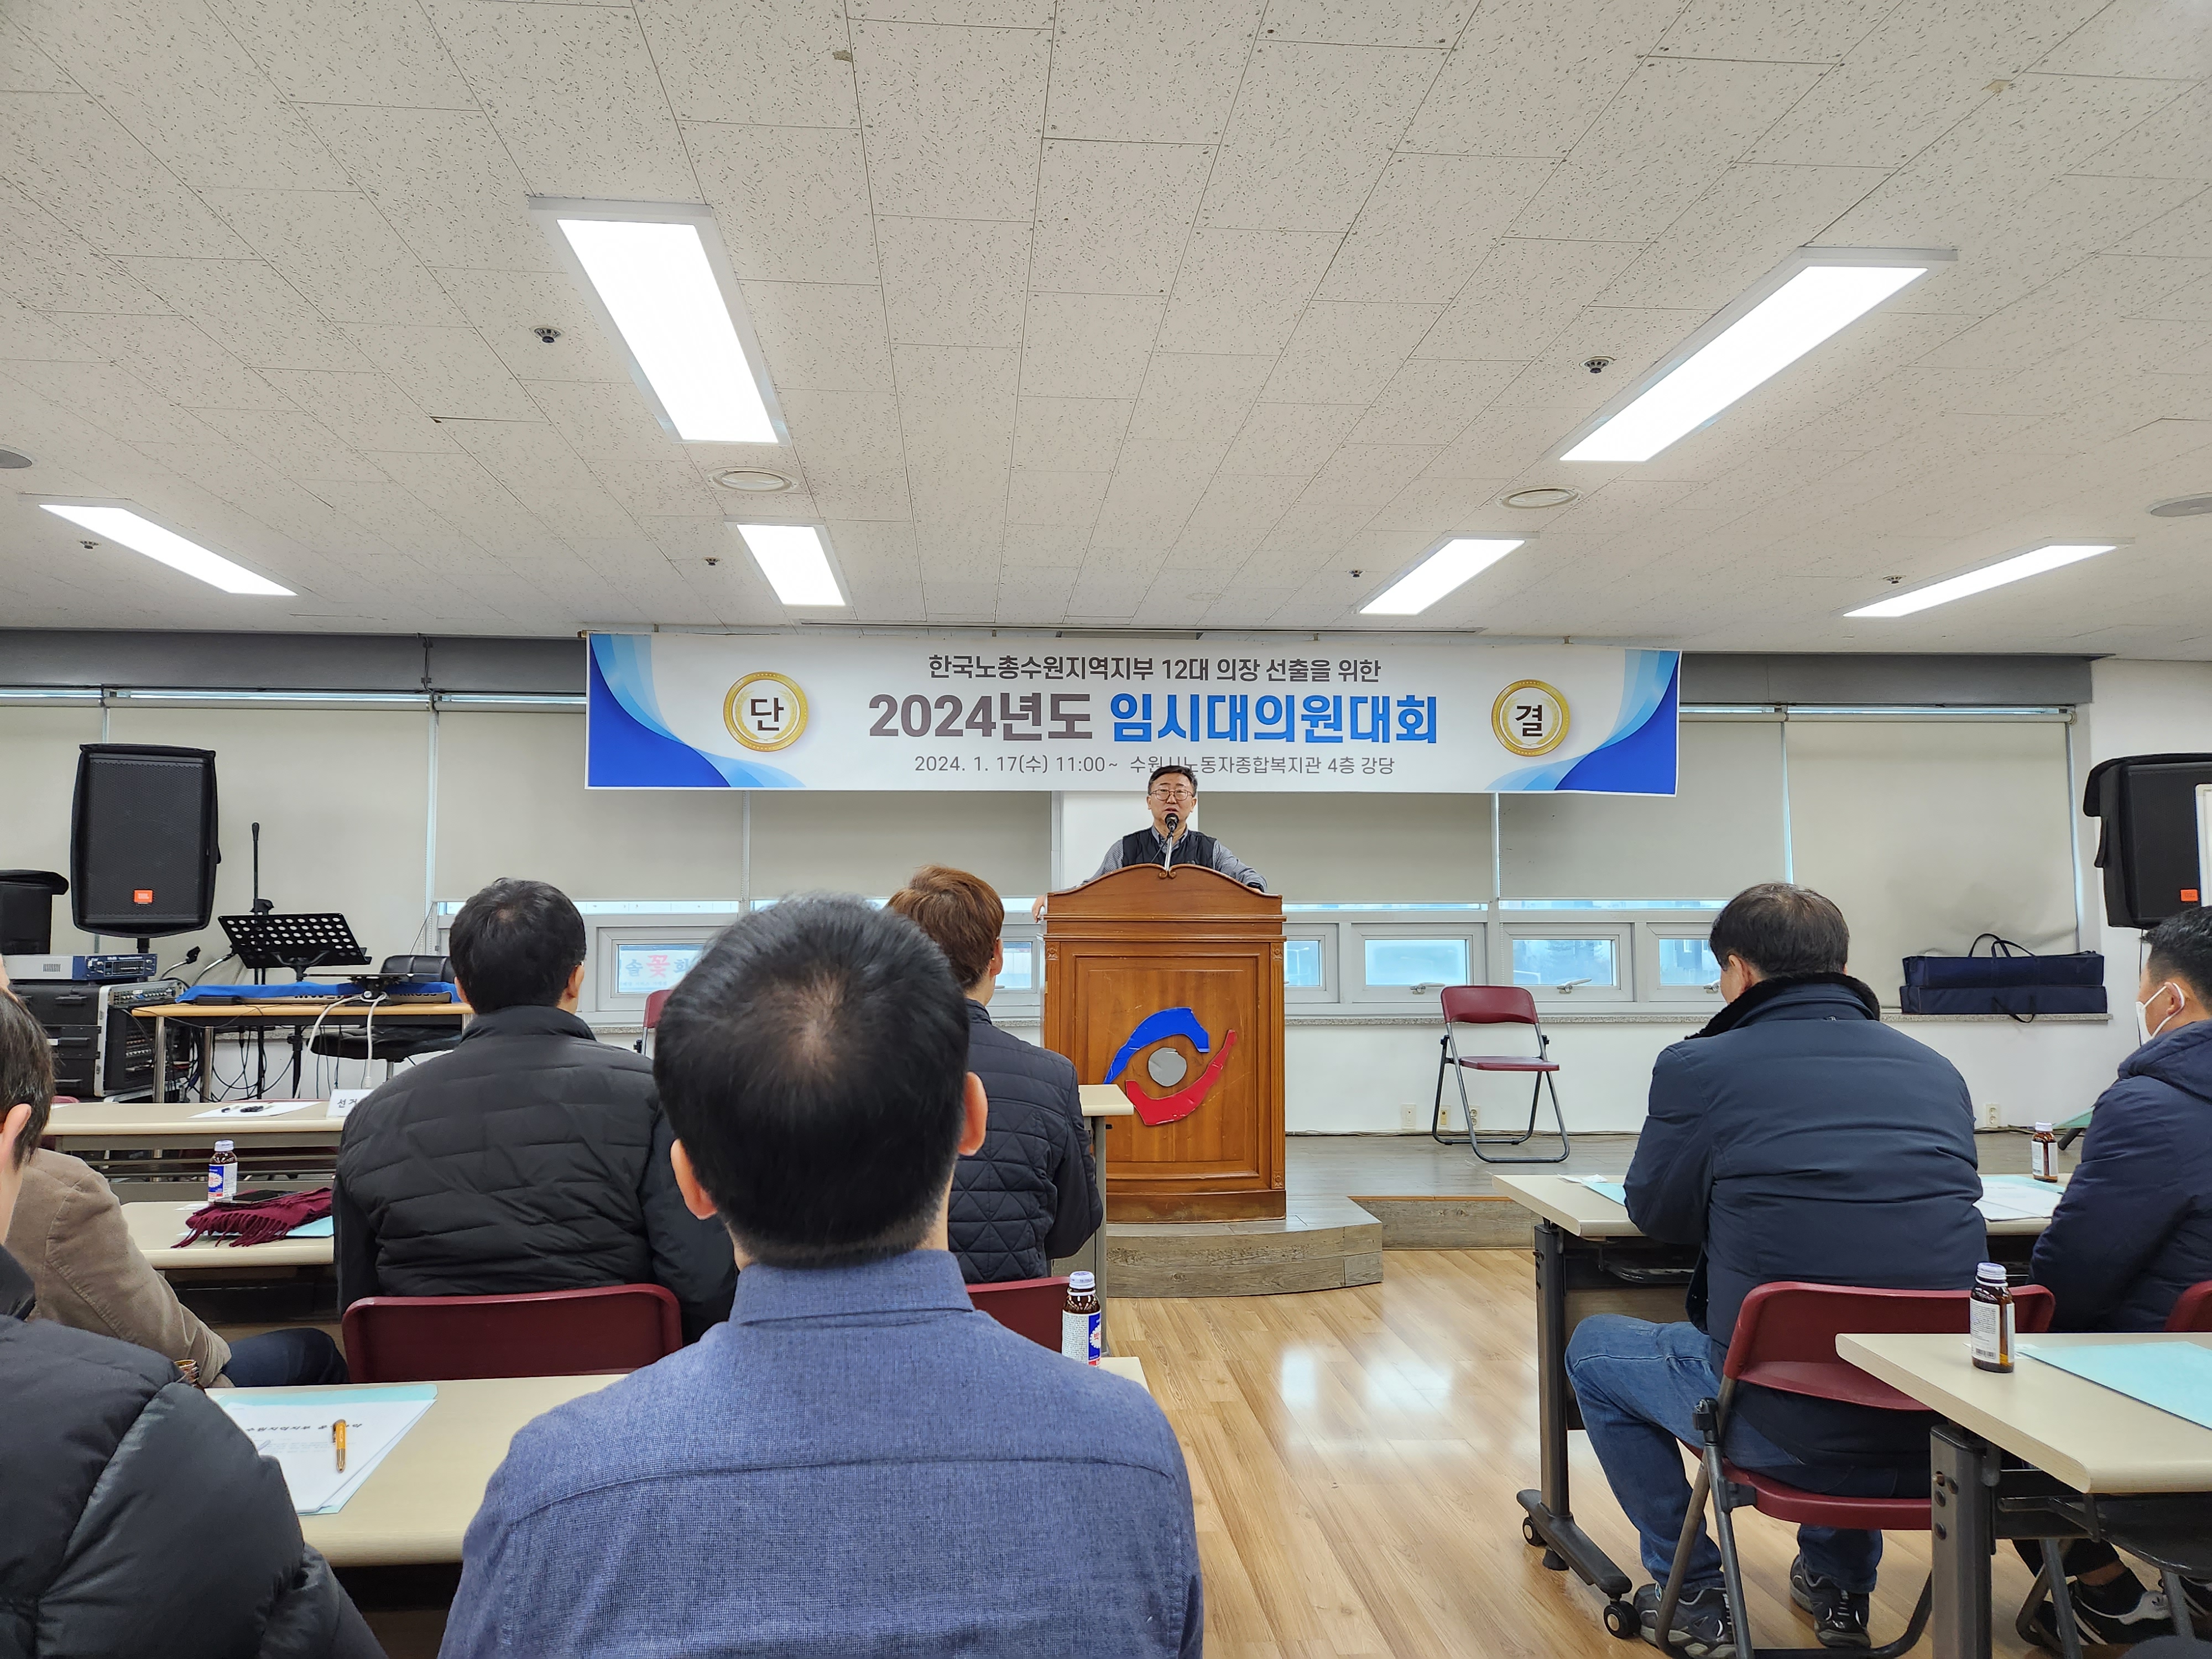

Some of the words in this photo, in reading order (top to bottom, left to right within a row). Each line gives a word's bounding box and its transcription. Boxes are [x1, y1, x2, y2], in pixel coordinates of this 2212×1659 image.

[928, 654, 1154, 681] 한국노총수원지역지부
[1162, 658, 1209, 681] 12대
[1217, 658, 1261, 682] 의장
[1266, 658, 1331, 682] 선출을
[1338, 659, 1382, 682] 위한
[750, 697, 784, 731] 단
[869, 692, 1093, 741] 2024년도
[1110, 693, 1437, 744] 임시대의원대회
[1515, 705, 1543, 737] 결
[915, 756, 965, 771] 2024.
[974, 756, 988, 771] 1.
[997, 754, 1048, 774] 17(수)
[1328, 757, 1355, 774] 4층
[1361, 757, 1395, 775] 강당
